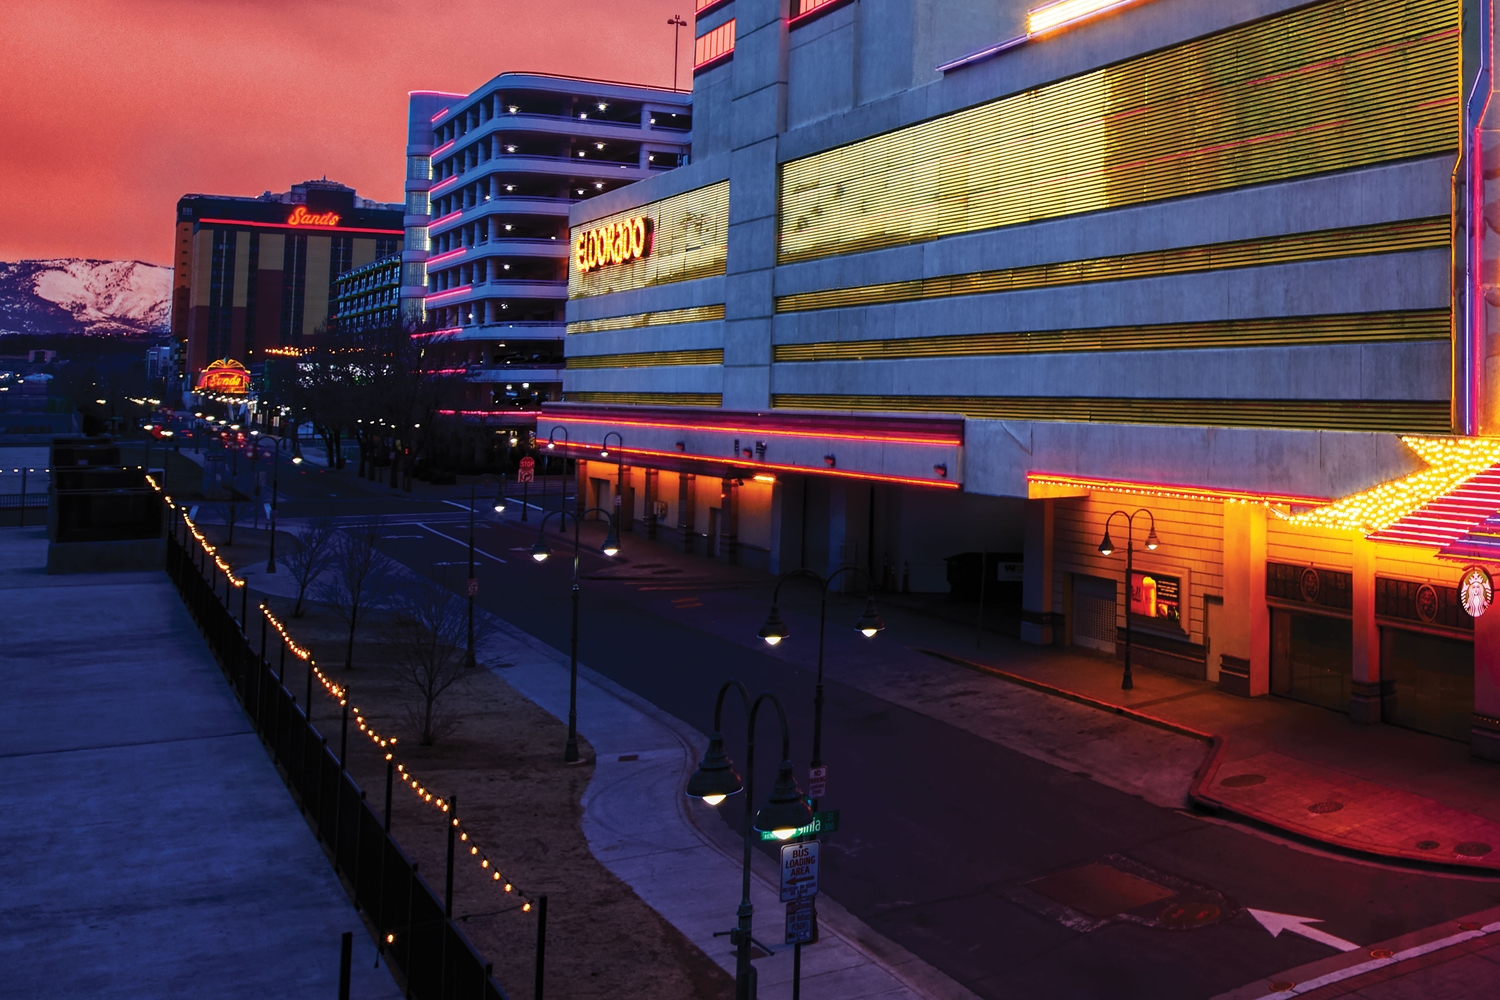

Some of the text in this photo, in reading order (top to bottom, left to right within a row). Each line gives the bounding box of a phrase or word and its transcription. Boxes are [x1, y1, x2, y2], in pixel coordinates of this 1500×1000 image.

[288, 205, 339, 226] Sands
[575, 216, 645, 272] ELDORADO
[824, 822, 835, 831] 300
[792, 847, 809, 859] BUS
[785, 856, 816, 869] LOADING
[790, 866, 810, 877] AREA
